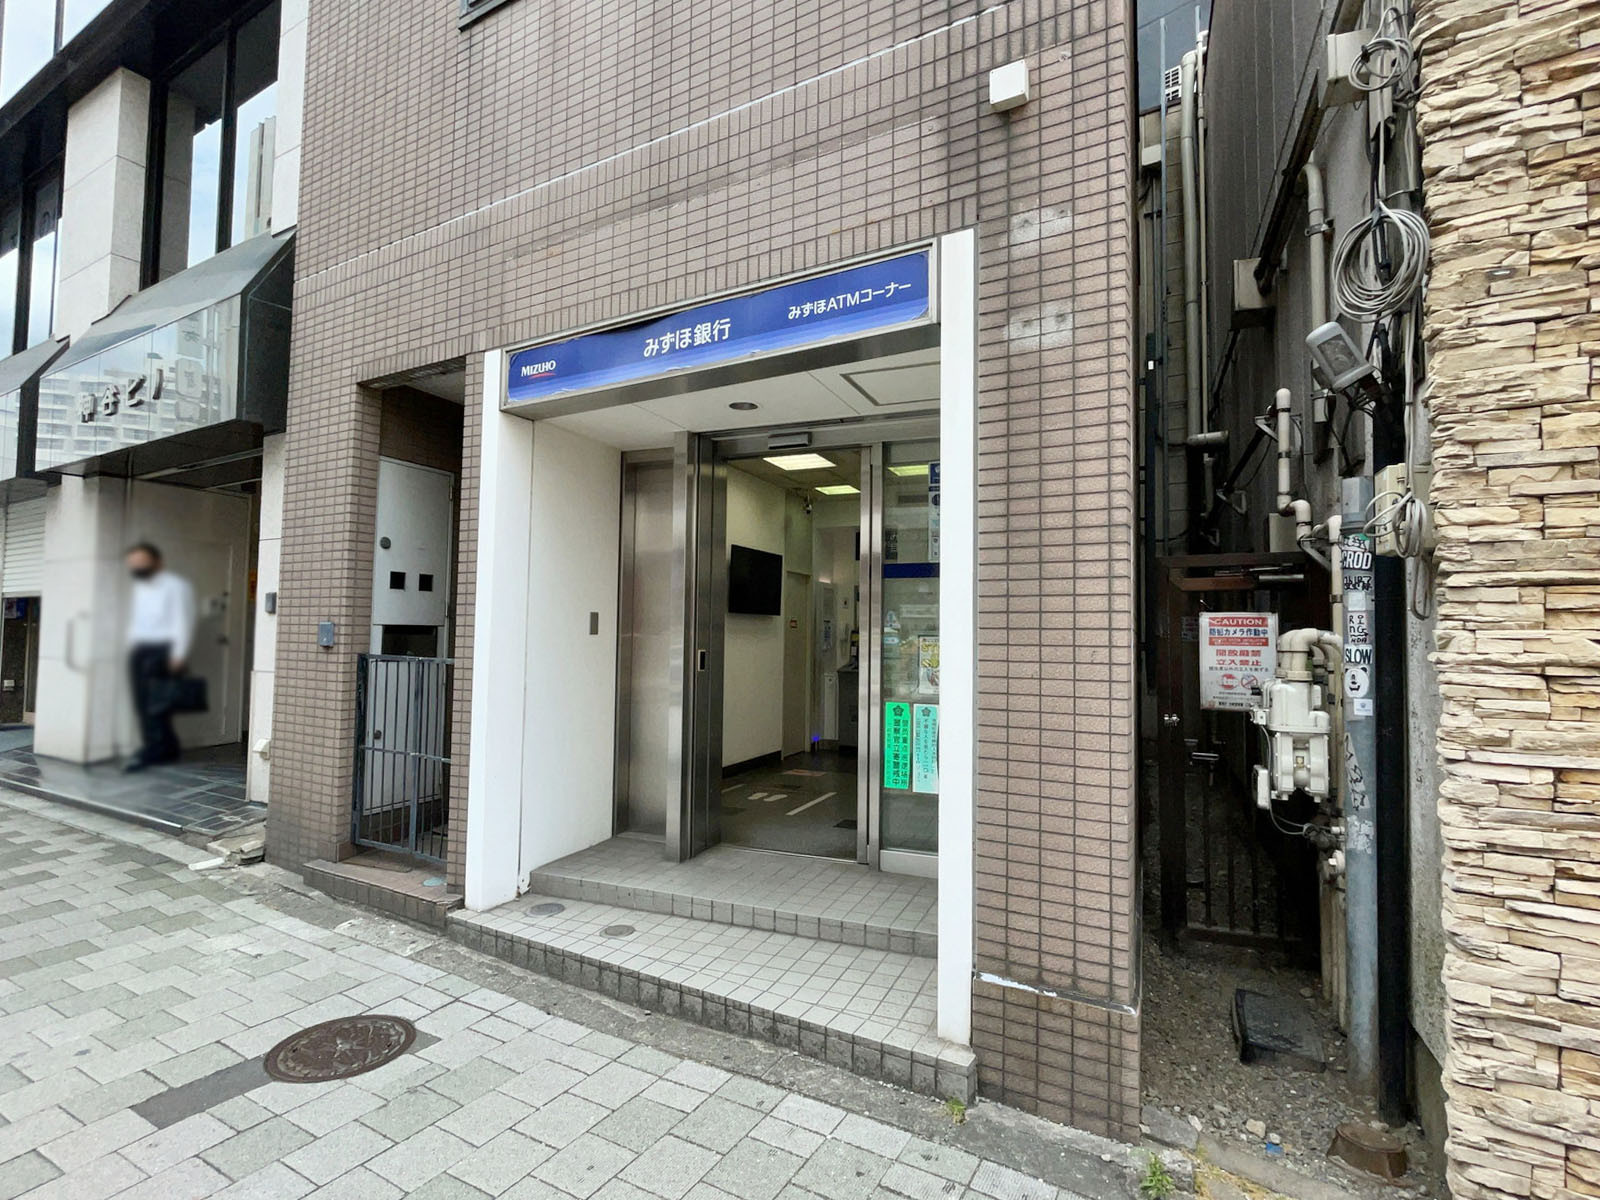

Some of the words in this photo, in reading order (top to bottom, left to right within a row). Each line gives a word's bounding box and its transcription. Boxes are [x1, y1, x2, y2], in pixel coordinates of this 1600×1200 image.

[788, 281, 911, 319] みずほATMコーナー
[643, 318, 731, 357] みずほ銀行
[521, 360, 556, 377] MIZUHO
[1209, 628, 1268, 636] 防犯カメラ作動中
[1345, 648, 1372, 664] SLOW
